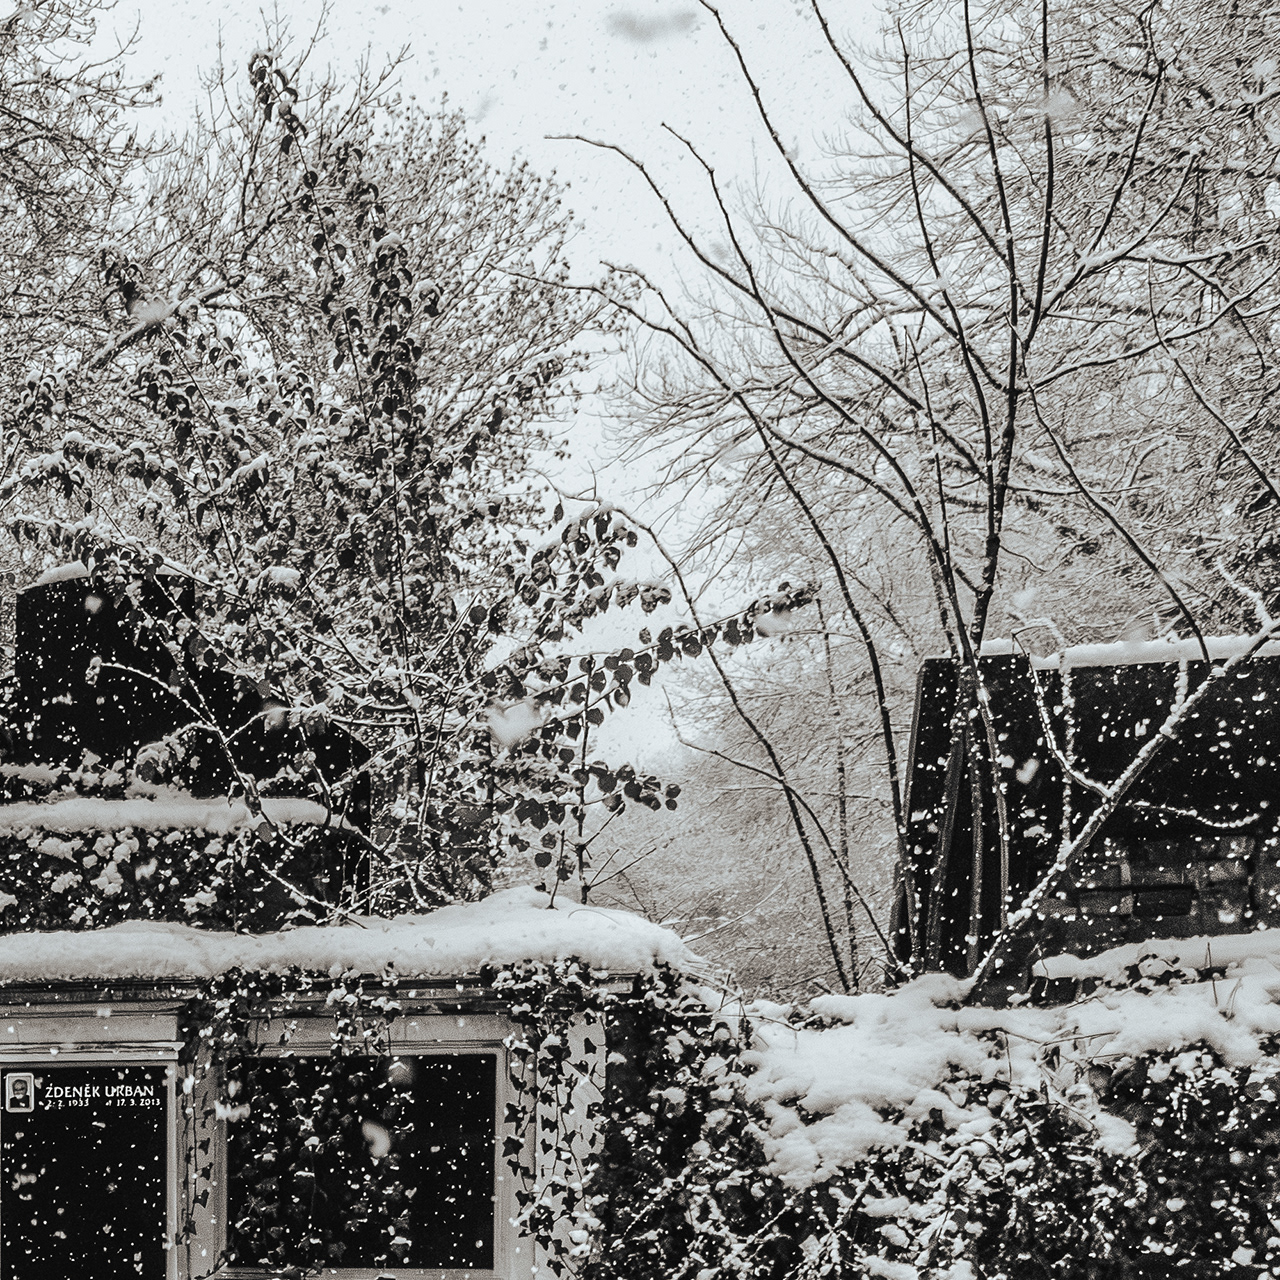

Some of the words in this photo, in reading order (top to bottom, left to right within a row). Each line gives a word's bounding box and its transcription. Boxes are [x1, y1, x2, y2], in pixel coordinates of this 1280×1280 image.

[44, 1083, 101, 1098] ZDENĚK
[104, 1084, 154, 1097] URBAN
[130, 1098, 138, 1107] 3.
[139, 1098, 161, 1107] 2013
